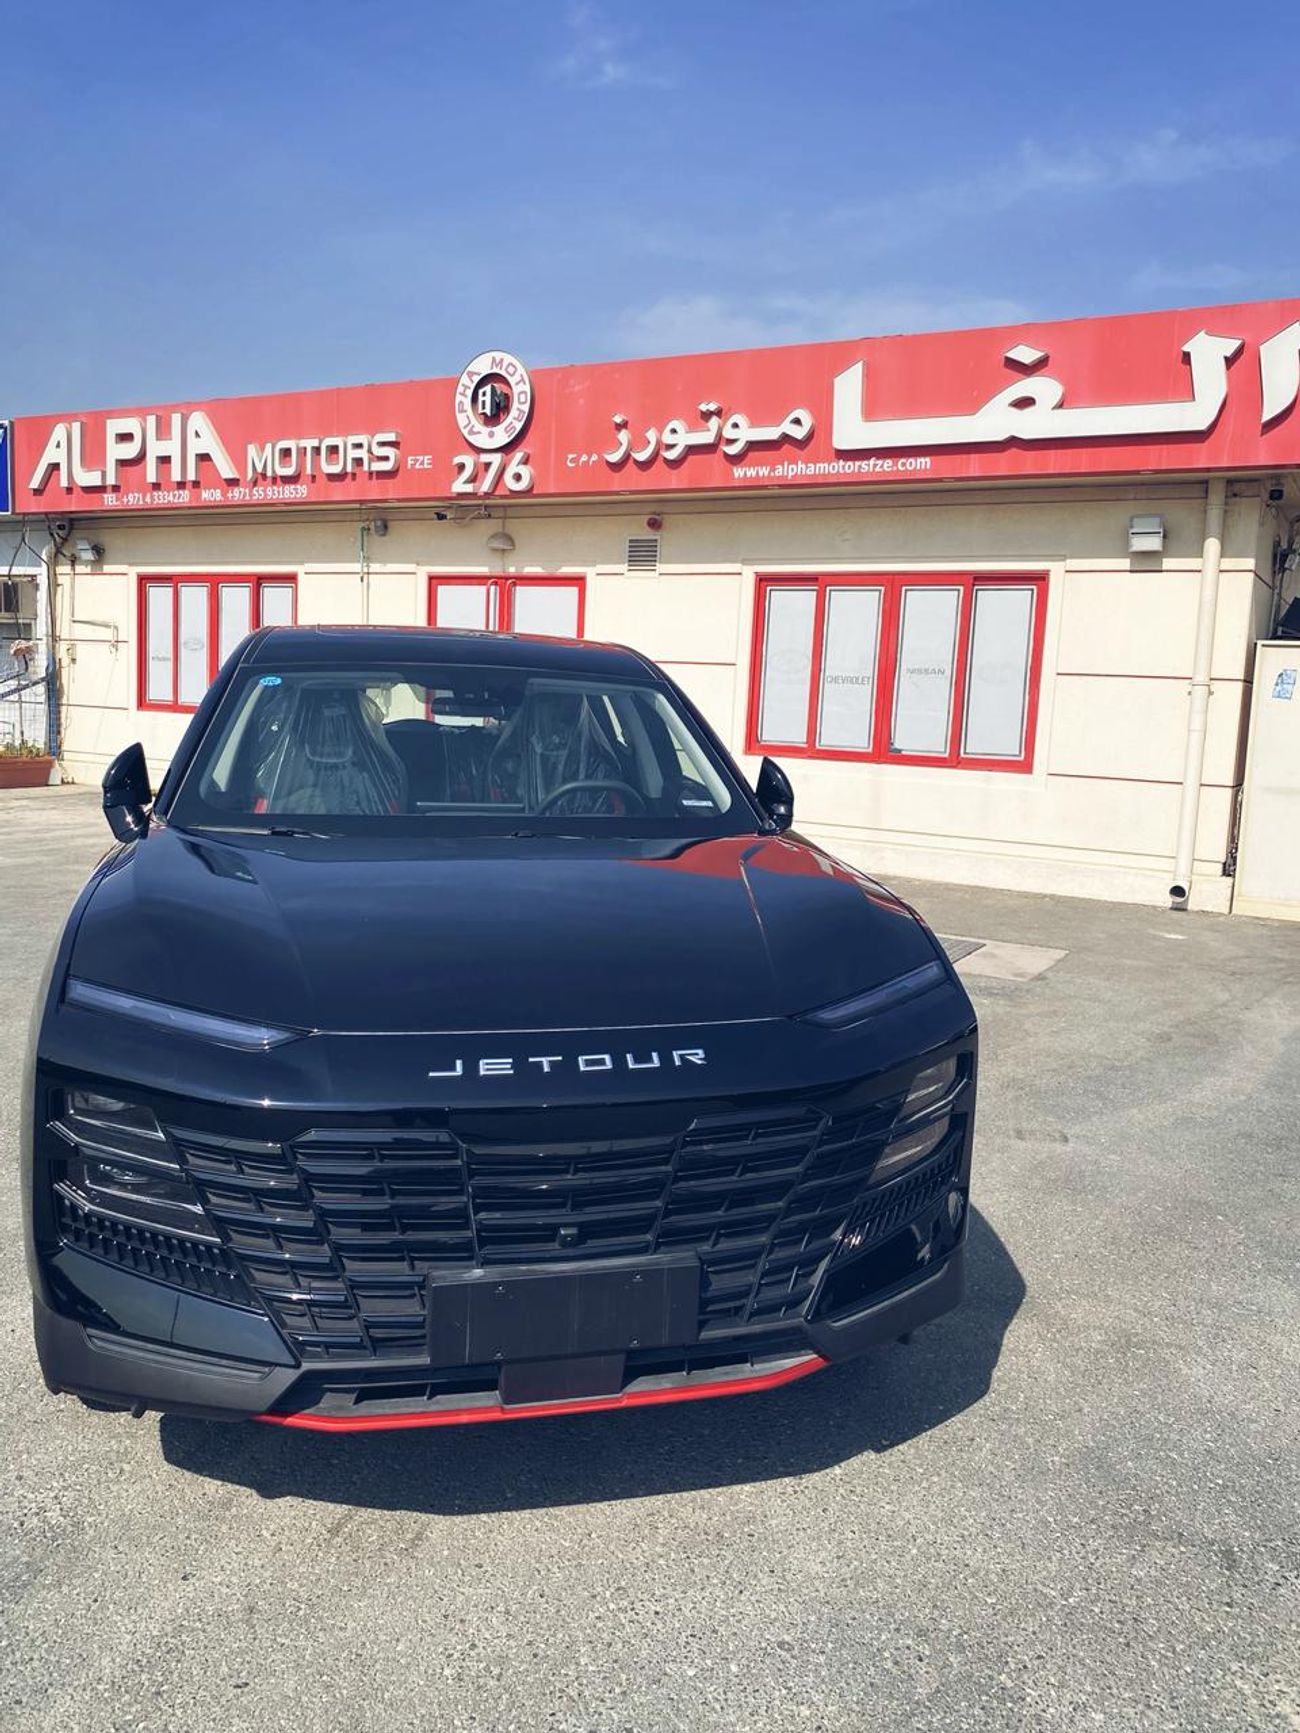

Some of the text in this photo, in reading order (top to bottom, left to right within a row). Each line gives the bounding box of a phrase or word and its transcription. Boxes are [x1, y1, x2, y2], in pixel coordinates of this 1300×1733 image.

[457, 356, 529, 438] ALPHA MOTORS
[603, 401, 814, 464] موتورز
[28, 411, 240, 490] ALPHA
[247, 432, 400, 478] MOTORS
[407, 455, 432, 470] FZE
[451, 451, 534, 495] 276
[732, 456, 931, 480] www.alphamotorsfze.com
[122, 492, 143, 505] +971
[145, 493, 151, 505] 4
[201, 488, 224, 501] MOB.
[227, 487, 250, 500] +971
[252, 486, 264, 499] 55
[826, 675, 872, 687] CHEVROLET
[906, 667, 945, 676] NISSAN
[428, 1048, 707, 1077] JETOUR
